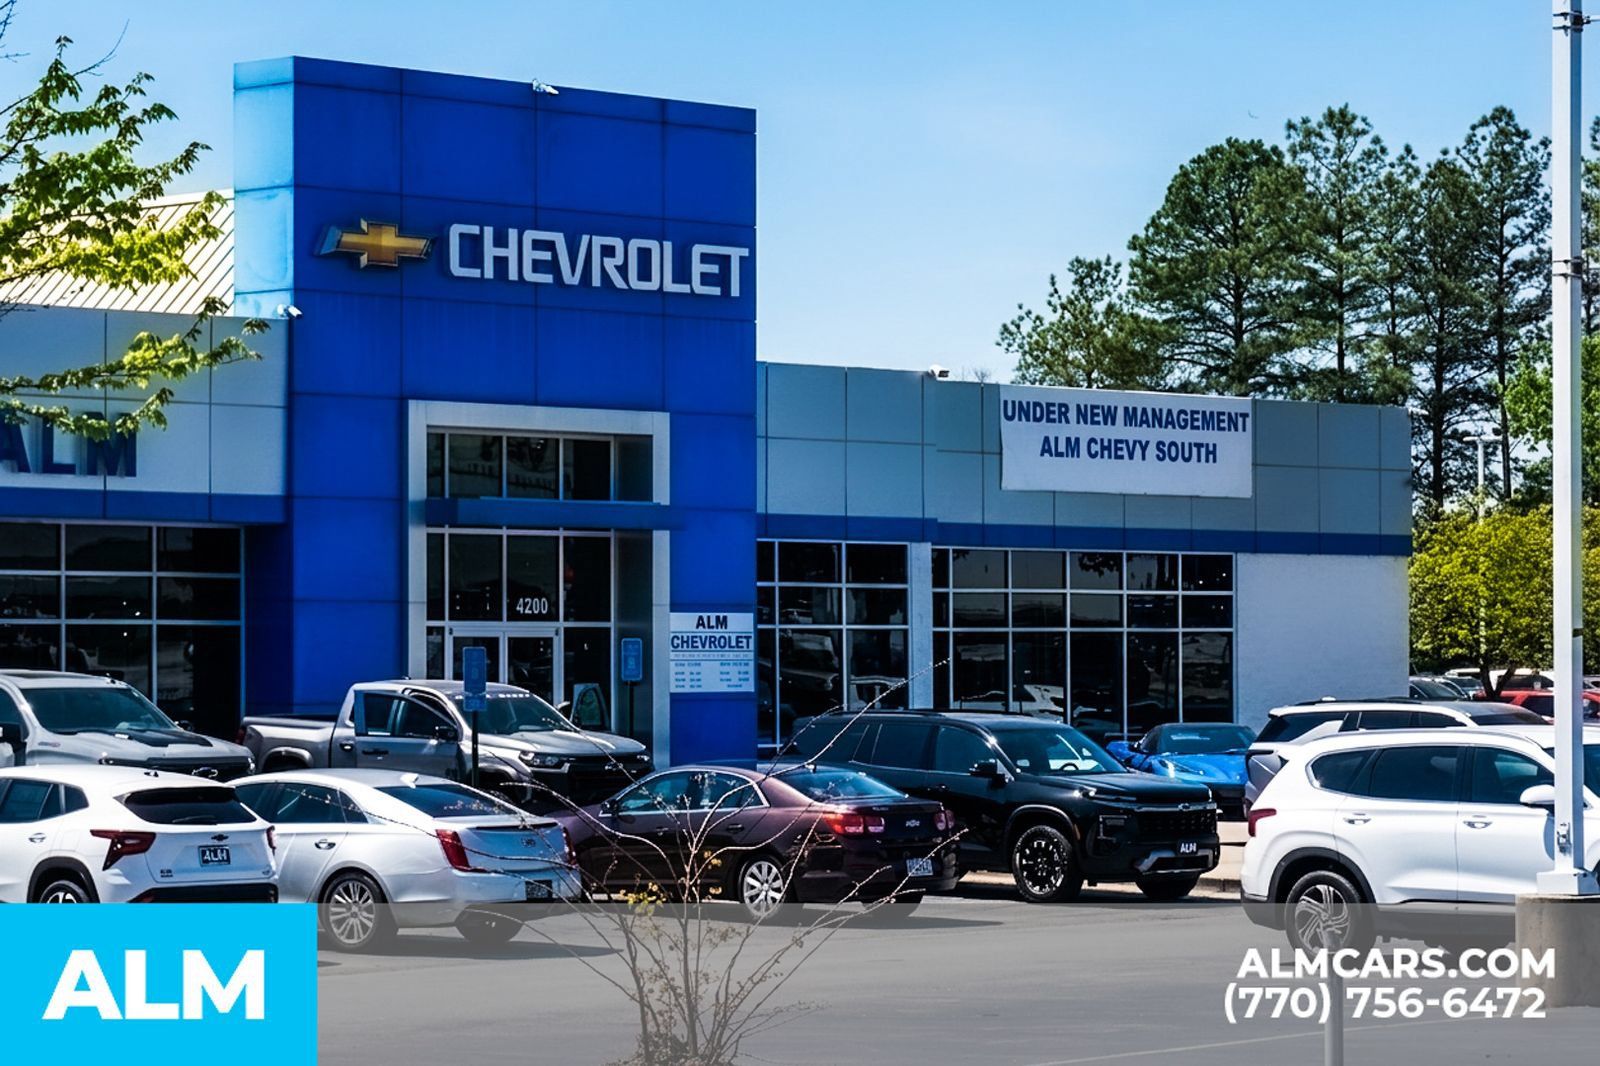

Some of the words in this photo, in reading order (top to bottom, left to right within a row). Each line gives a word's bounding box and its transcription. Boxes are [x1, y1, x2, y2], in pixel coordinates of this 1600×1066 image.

[448, 223, 750, 298] CHEVROLET
[1003, 399, 1070, 425] UNDER
[1076, 404, 1118, 426] NEW
[1123, 406, 1250, 432] MANAGEMENT
[1040, 435, 1080, 459] ALM
[1087, 437, 1150, 461] CHEVY
[1156, 440, 1217, 464] SOUTH
[516, 597, 548, 614] 4200
[696, 615, 728, 630] ALM
[671, 635, 752, 649] CHEVROLET
